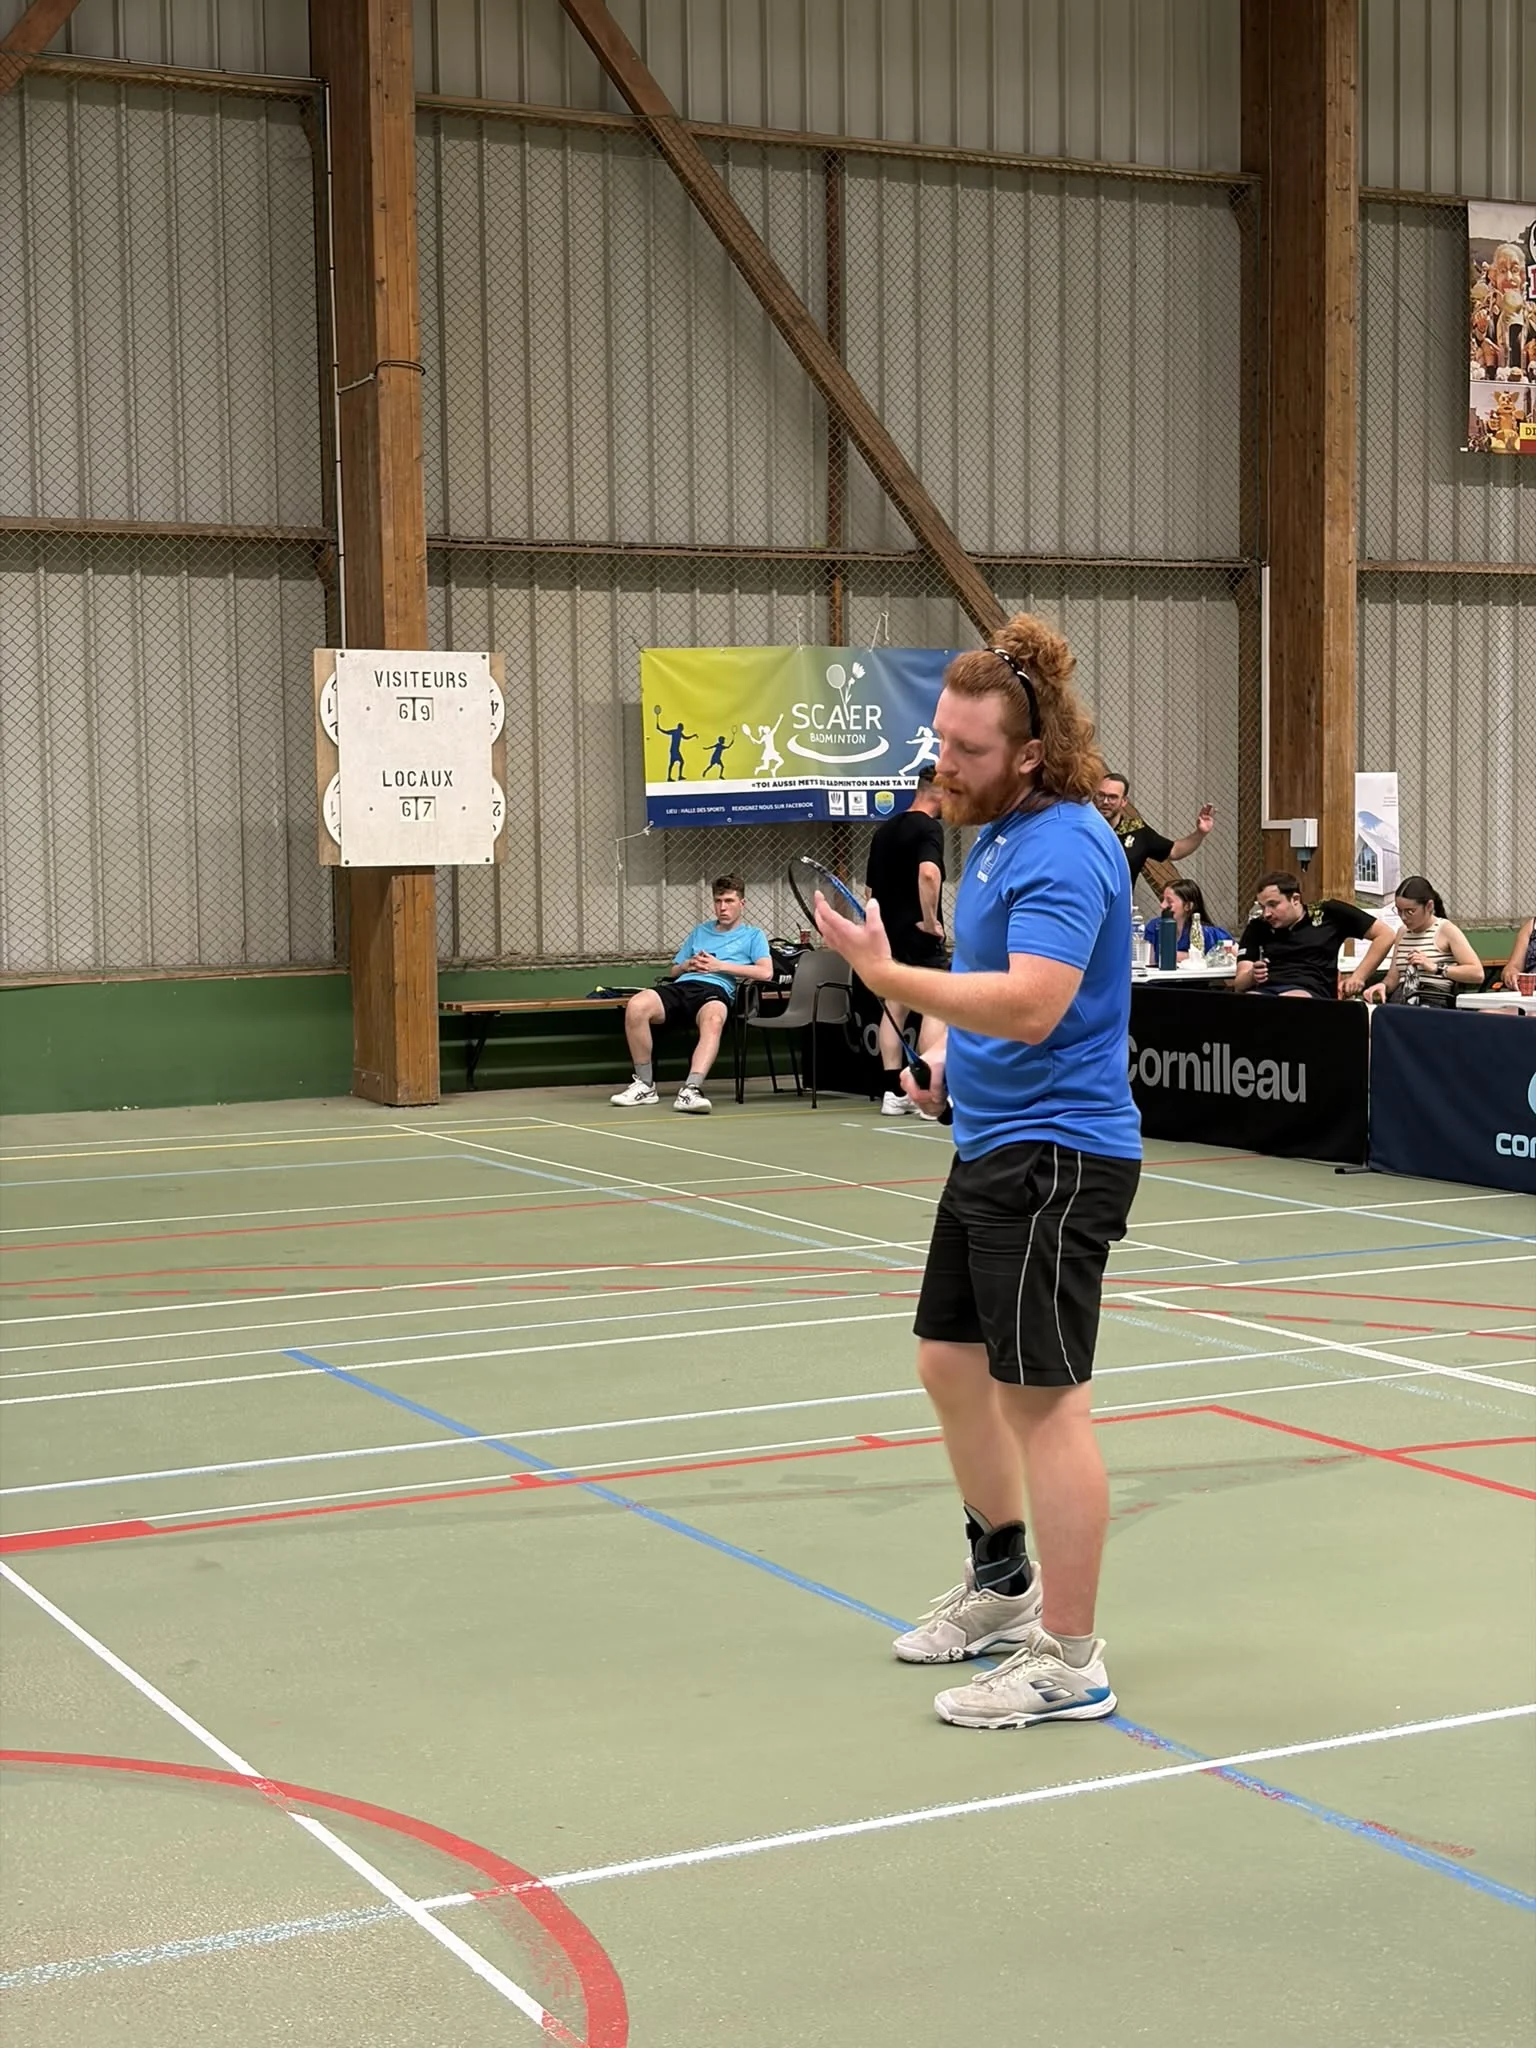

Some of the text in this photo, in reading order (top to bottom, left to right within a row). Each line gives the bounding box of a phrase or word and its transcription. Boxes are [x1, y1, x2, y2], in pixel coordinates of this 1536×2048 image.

[374, 670, 468, 688] VISITEURS
[791, 702, 883, 730] SCAER
[809, 732, 866, 745] BADMINTON
[382, 770, 453, 787] LOCAUX
[772, 780, 796, 788] AUSSI
